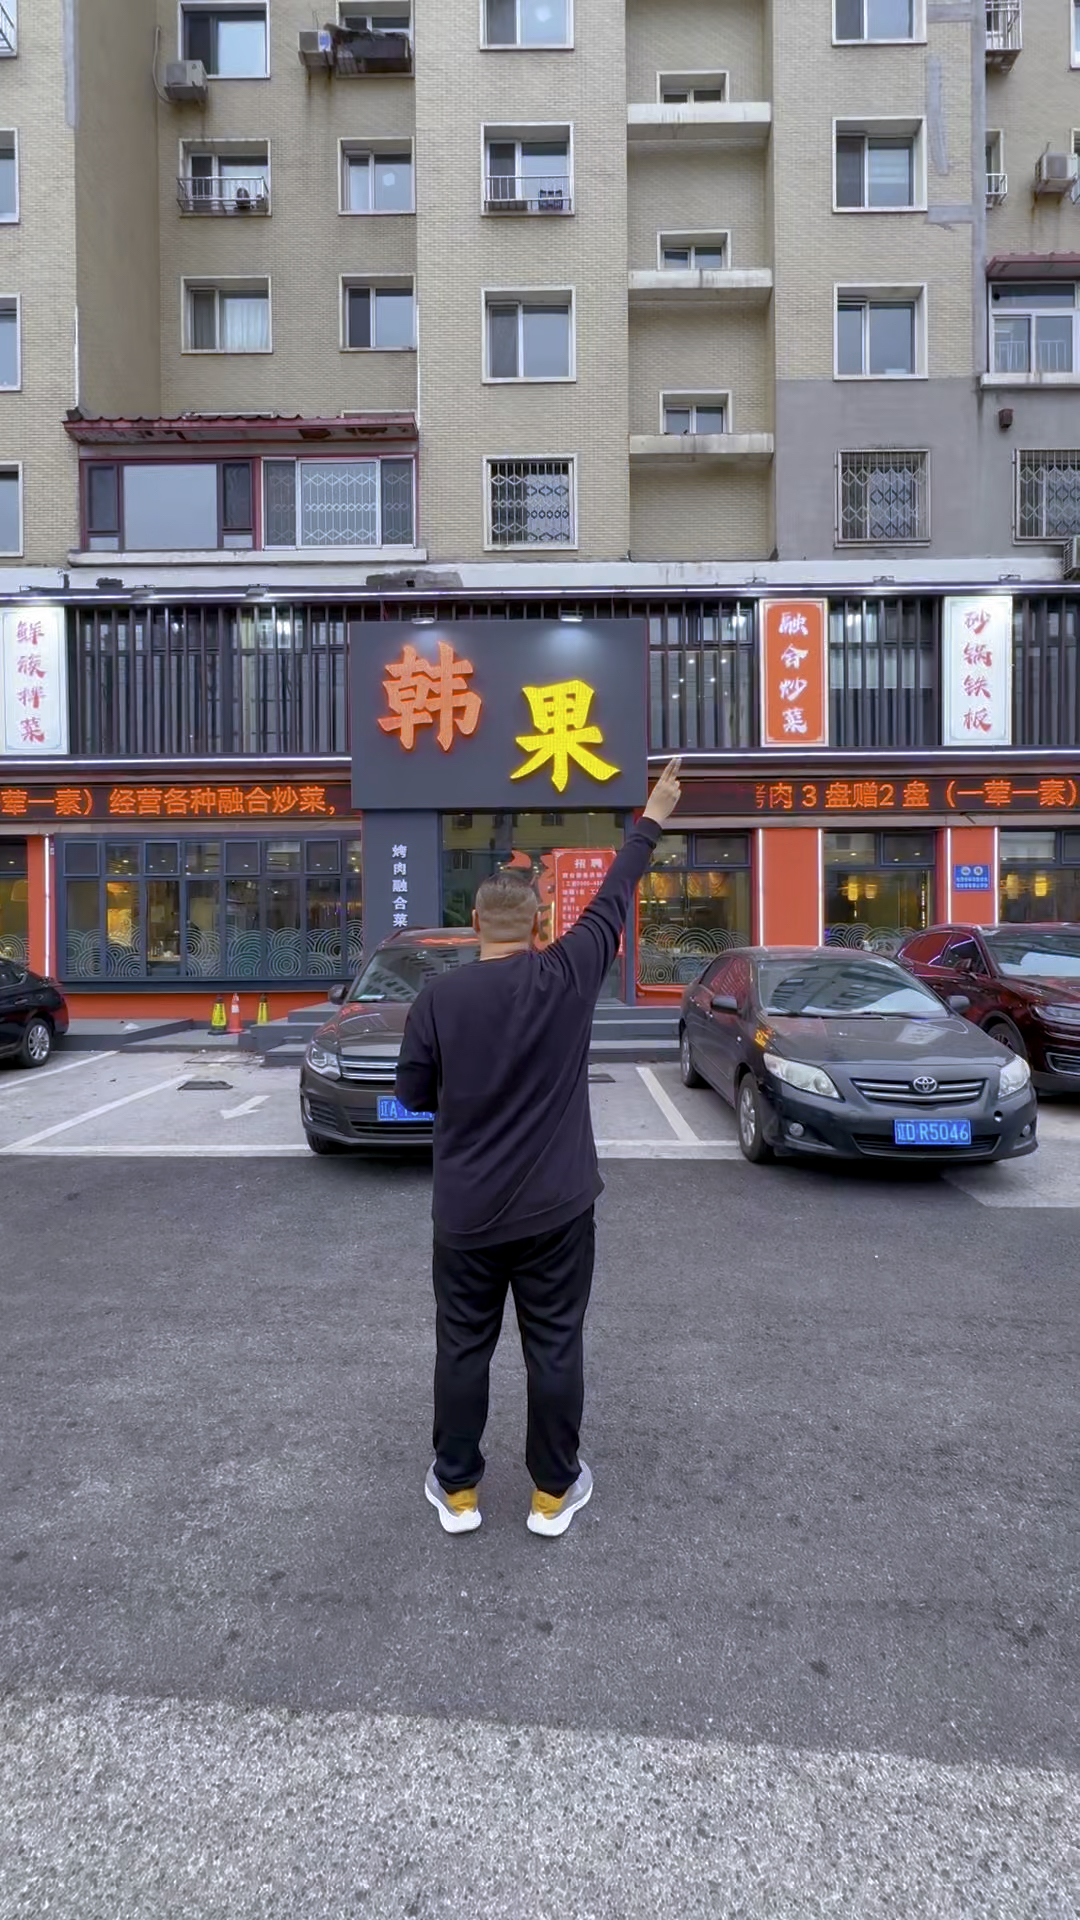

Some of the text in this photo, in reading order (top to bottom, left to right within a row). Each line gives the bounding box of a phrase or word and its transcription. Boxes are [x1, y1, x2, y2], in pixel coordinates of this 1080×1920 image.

[16, 620, 46, 743] 鲜族拌菜
[778, 611, 809, 734] 融合炒菜
[963, 608, 992, 732] 砂锅铁板
[392, 844, 408, 927] 烤肉融合菜
